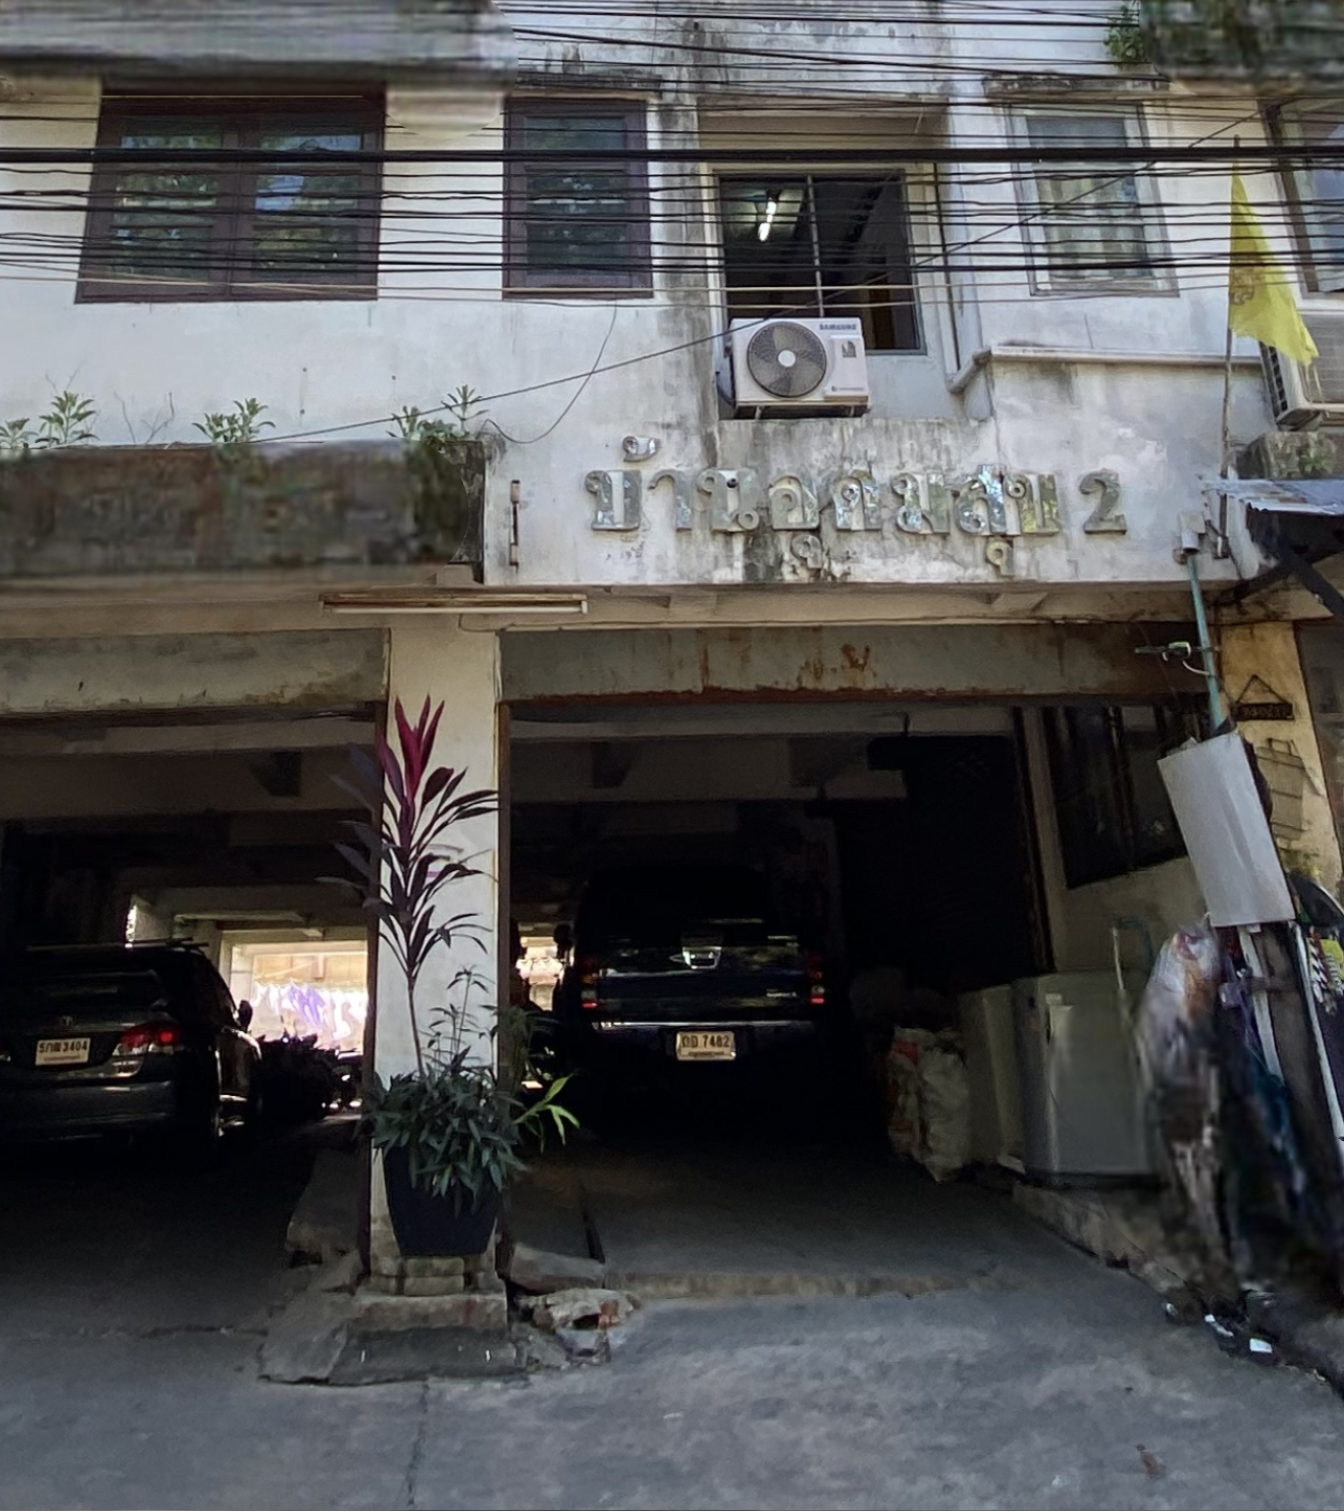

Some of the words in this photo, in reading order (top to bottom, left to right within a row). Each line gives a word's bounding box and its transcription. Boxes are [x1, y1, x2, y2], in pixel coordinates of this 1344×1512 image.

[584, 434, 1062, 578] บ้านอุดมสุข
[1080, 470, 1128, 535] 2
